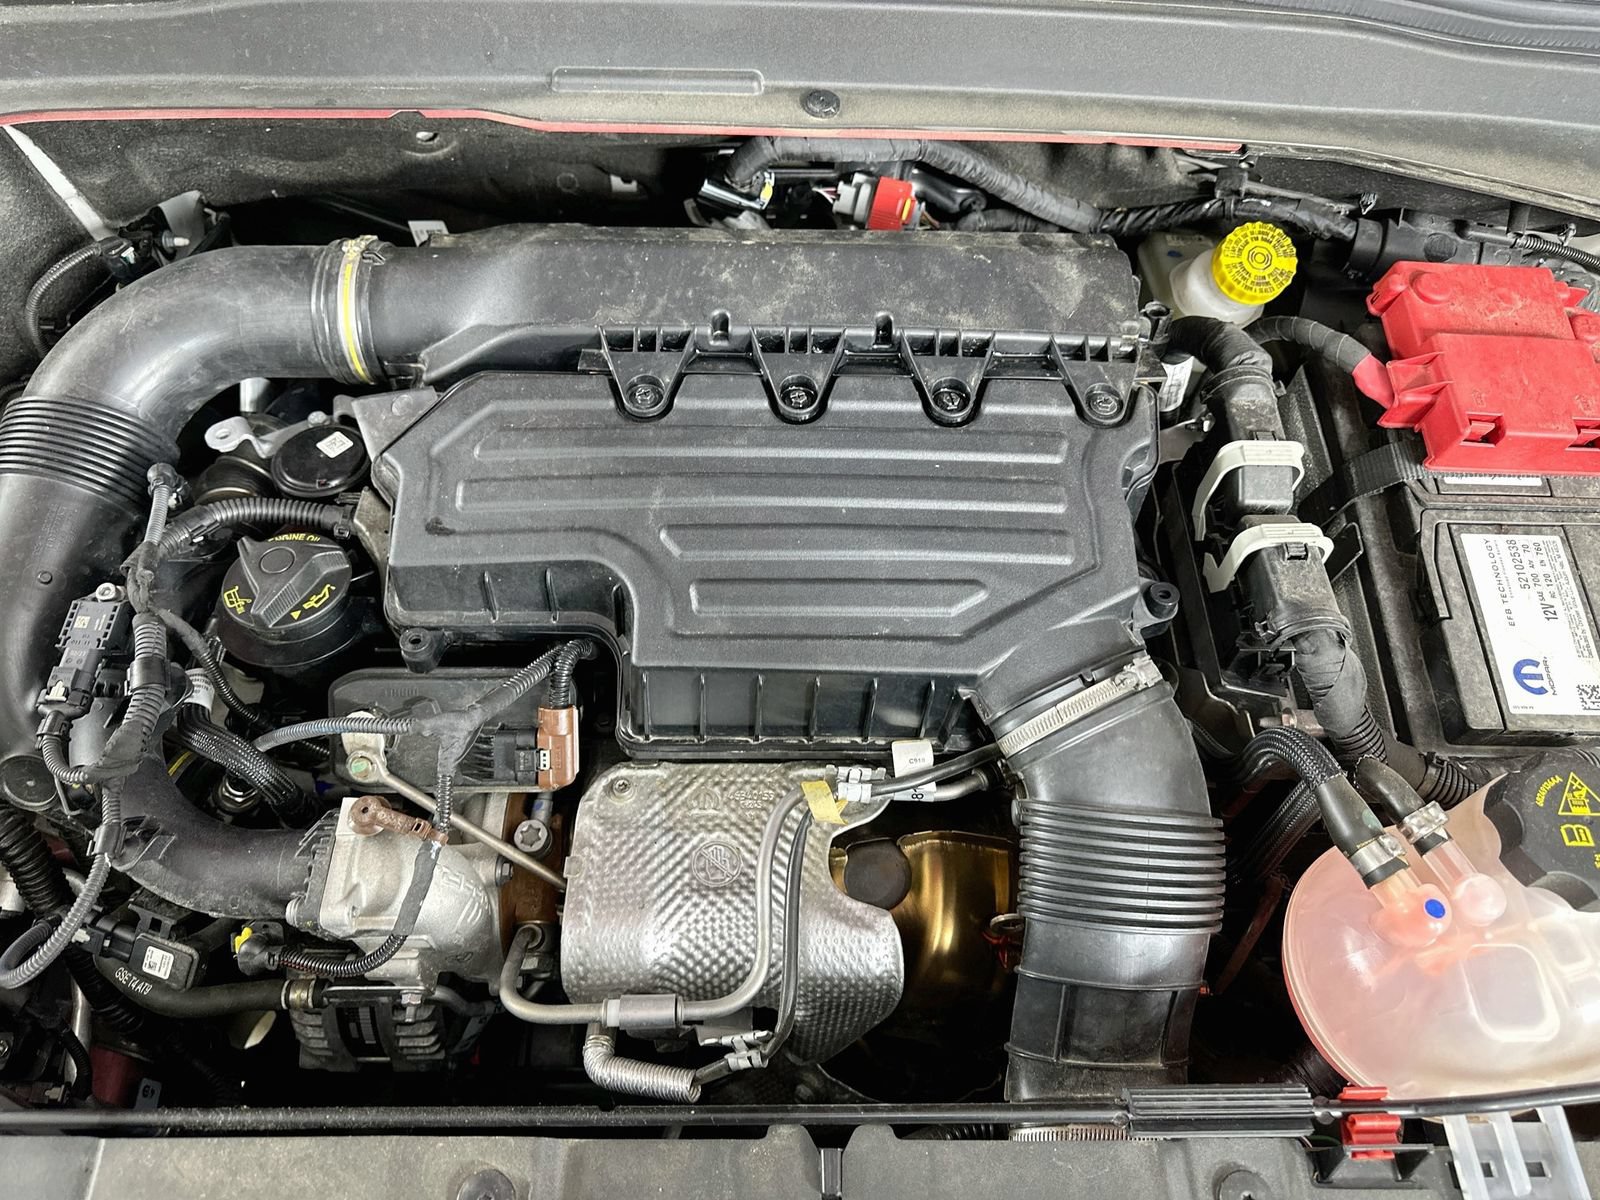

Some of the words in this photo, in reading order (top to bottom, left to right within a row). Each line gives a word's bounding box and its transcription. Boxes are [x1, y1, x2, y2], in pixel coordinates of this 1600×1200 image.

[1521, 544, 1531, 553] 70
[1533, 542, 1543, 556] 760
[1483, 538, 1508, 604] TECHNOLOGY
[1505, 539, 1531, 590] 52102538
[1530, 573, 1542, 587] 700
[1542, 573, 1553, 587] 120
[1504, 608, 1516, 627] EFB
[1540, 603, 1559, 621] 12V
[1543, 659, 1558, 696] MOPAR
[115, 966, 132, 985] GSE
